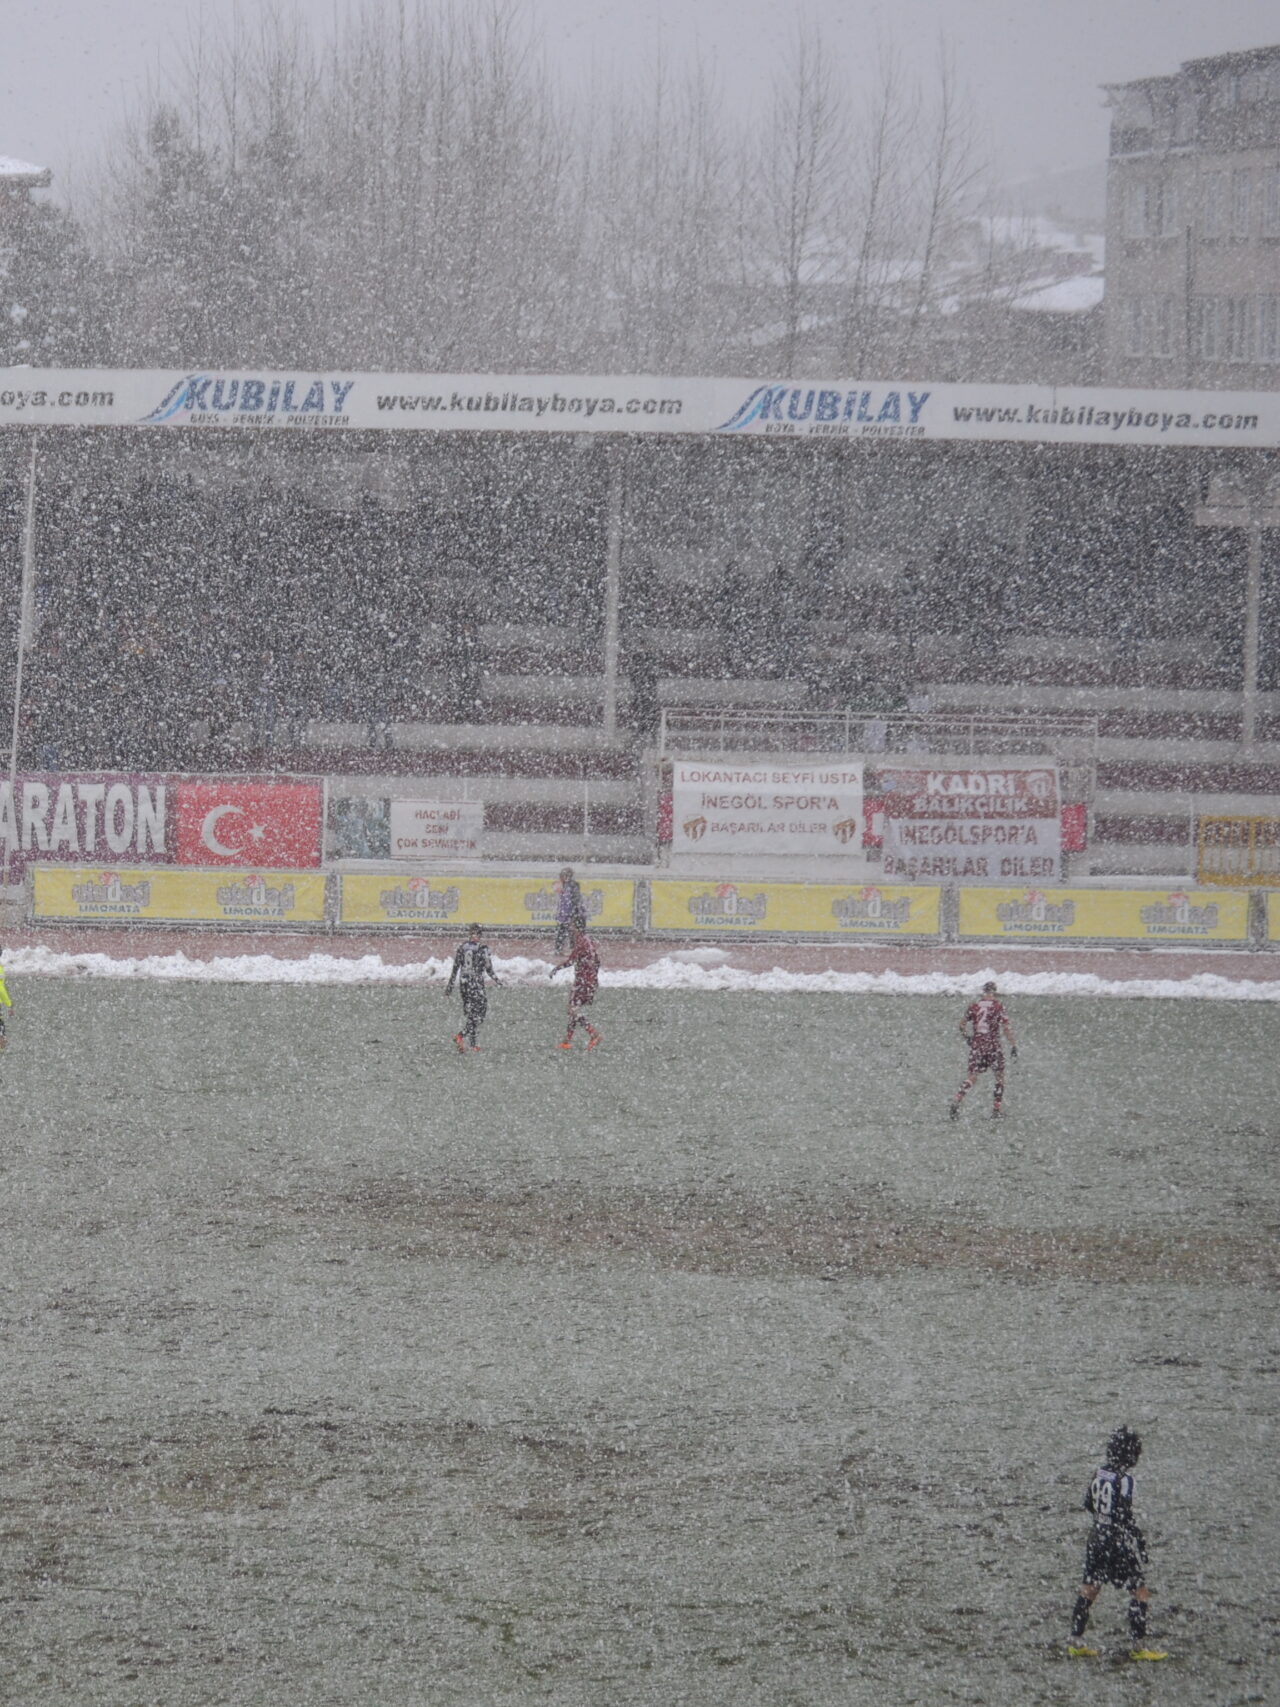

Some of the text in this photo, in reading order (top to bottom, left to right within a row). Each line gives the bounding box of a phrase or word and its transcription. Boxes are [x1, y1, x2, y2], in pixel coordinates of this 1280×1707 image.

[376, 392, 683, 417] www.kubilayboya.com
[952, 405, 1258, 432] www.kubilayboya.com
[820, 772, 858, 784] USTA
[1091, 1478, 1113, 1515] 99
